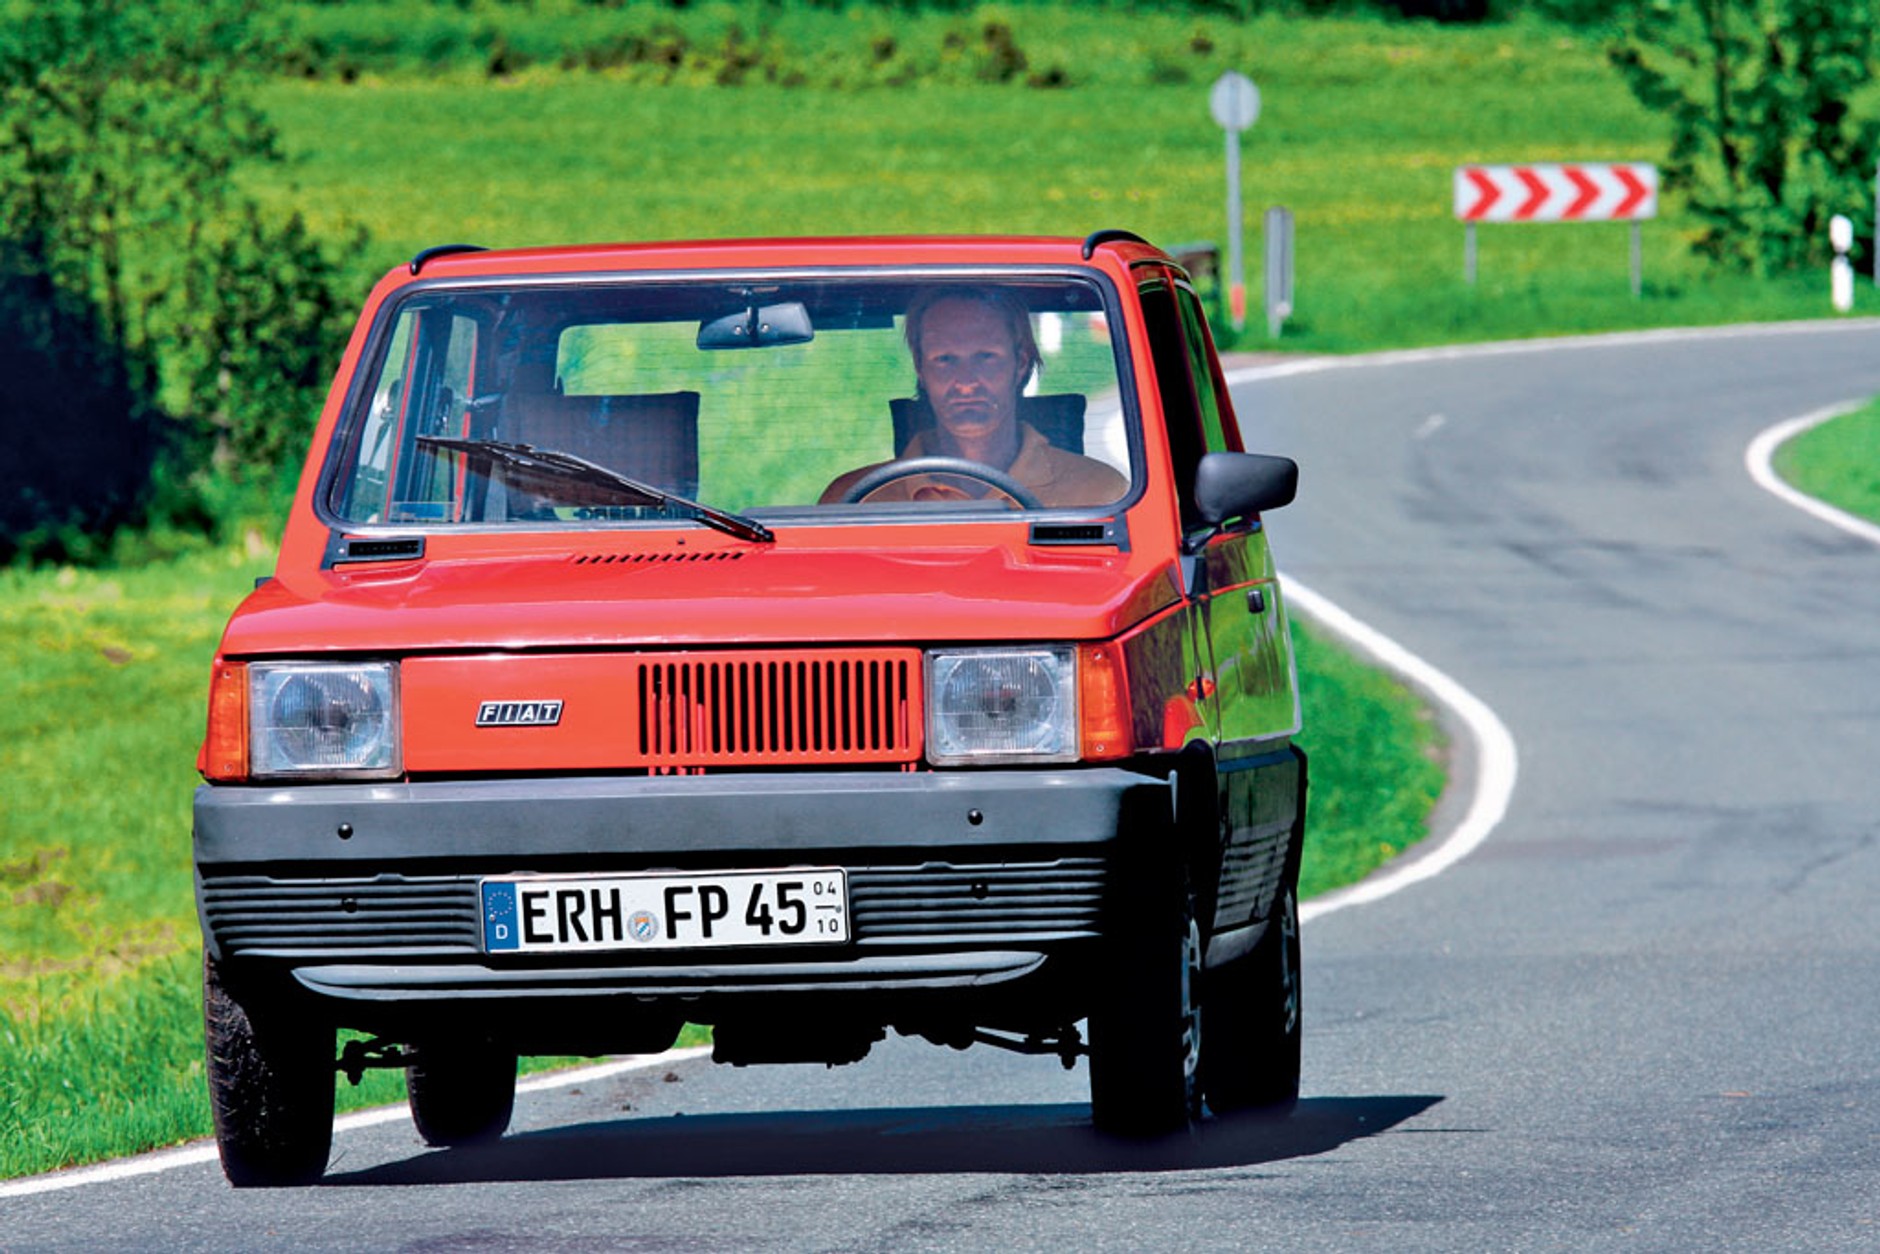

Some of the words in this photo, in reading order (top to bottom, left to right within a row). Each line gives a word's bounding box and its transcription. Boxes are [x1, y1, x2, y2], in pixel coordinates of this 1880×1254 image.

[482, 704, 558, 721] FIAT
[813, 881, 837, 895] 04
[521, 888, 623, 944] ERH
[663, 885, 729, 939] FP
[745, 882, 808, 936] 45
[495, 925, 508, 940] D
[817, 918, 839, 934] 10
